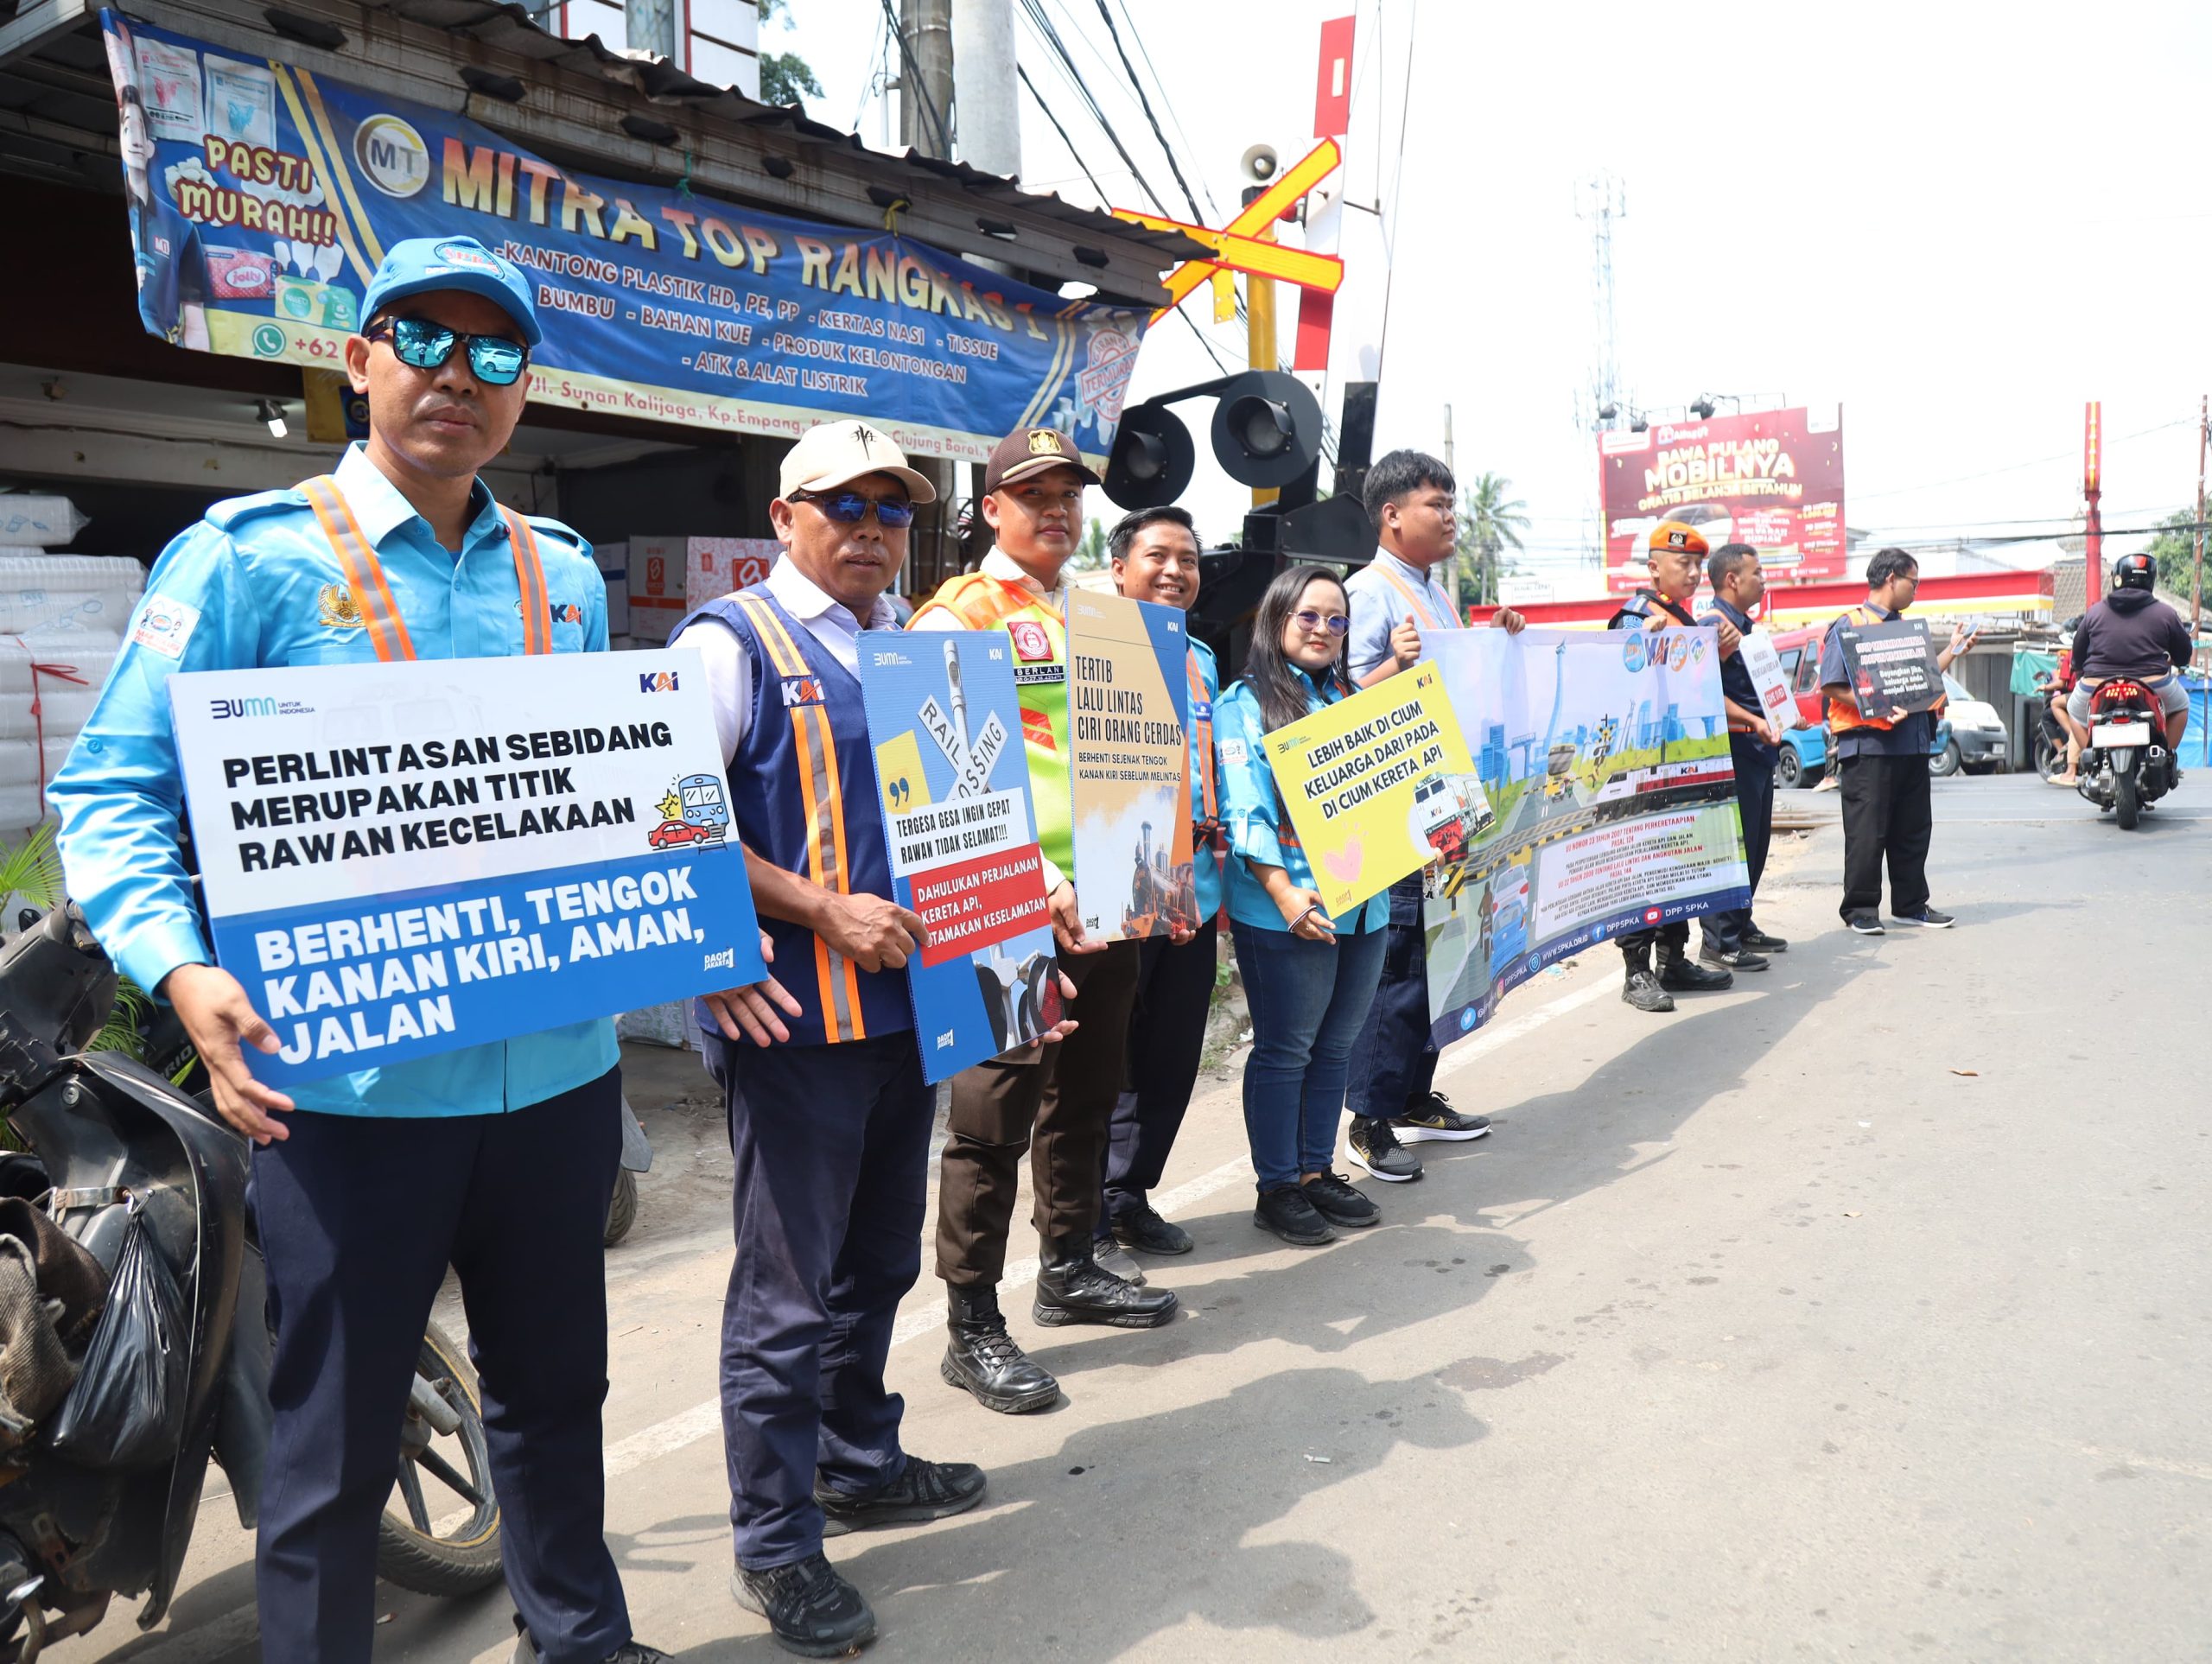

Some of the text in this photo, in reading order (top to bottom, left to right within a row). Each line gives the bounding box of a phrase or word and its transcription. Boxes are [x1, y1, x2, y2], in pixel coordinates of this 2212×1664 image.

[205, 137, 312, 193] PASTI
[178, 181, 336, 246] MURAH!!
[443, 137, 659, 251] MITRA
[662, 207, 781, 276] TOP
[794, 236, 1014, 333] RANGKAS
[623, 266, 705, 302] PLASTIK
[709, 286, 741, 314] HD,
[746, 294, 773, 321] PE,
[778, 300, 799, 320] PP
[818, 310, 885, 338] KERTAS
[888, 323, 925, 345] NASI
[948, 333, 998, 360] TISSUE
[538, 285, 966, 384] BUMBU BAHAN KUE PRODUK KELONTONGAN
[694, 352, 734, 378] ATK
[752, 363, 797, 385] ALAT
[802, 371, 868, 397] LISTRIK
[533, 377, 553, 394] Jl.
[562, 382, 617, 405] Sunan
[624, 392, 702, 420] Kalijaga,
[892, 430, 942, 454] Ciujung
[1657, 438, 1780, 466] BAWA PULANG
[1644, 453, 1795, 492] MOBILNYA
[1167, 621, 1179, 632] KAI
[989, 648, 1002, 660] KAI
[1017, 666, 1059, 676] BERLAN
[1076, 656, 1113, 683] TERTIB
[639, 671, 679, 693] KAI
[781, 679, 825, 706] KAI
[1077, 686, 1143, 715] LALU LINTAS
[1417, 674, 1433, 689] KAI
[278, 701, 302, 709] UNTUK
[279, 707, 315, 715] INDONESIA
[923, 702, 961, 765] RAIL
[1077, 715, 1181, 746] CIRI ORANG CERDAS
[1307, 701, 1423, 769] LEBIH BAIK DI CIUM
[223, 721, 672, 789] PERLINTASAN SEBIDANG
[1078, 752, 1167, 765] BERHENTI SEJENAK TENGOK
[1304, 721, 1440, 799] KELUARGA DARI PADA
[1680, 765, 1699, 775] KAI
[1079, 769, 1180, 782] KANAN KIRI SEBELUM MELINTAS
[1322, 746, 1443, 819] DI CIUM KERETA API
[231, 767, 576, 831] MERUPAKAN TITIK
[896, 798, 1011, 838] TERGESA GESA INGIN CEPAT
[238, 797, 636, 873] RAWAN KECELAKAAN
[900, 824, 1008, 865] RAWAN TIDAK SELAMAT!!!
[918, 856, 1039, 903] DAHULUKAN PERJALANAN
[254, 865, 698, 973] BERHENTI, TENGOK
[921, 897, 982, 926] KERETA API,
[983, 897, 1046, 929] KESELAMATAN
[1606, 916, 1640, 933] DPPSPKA
[1665, 901, 1709, 917] DPP SPKA
[264, 907, 706, 1019] KANAN KIRI, AMAN,
[704, 951, 727, 964] DAOP
[277, 994, 457, 1065] JALAN
